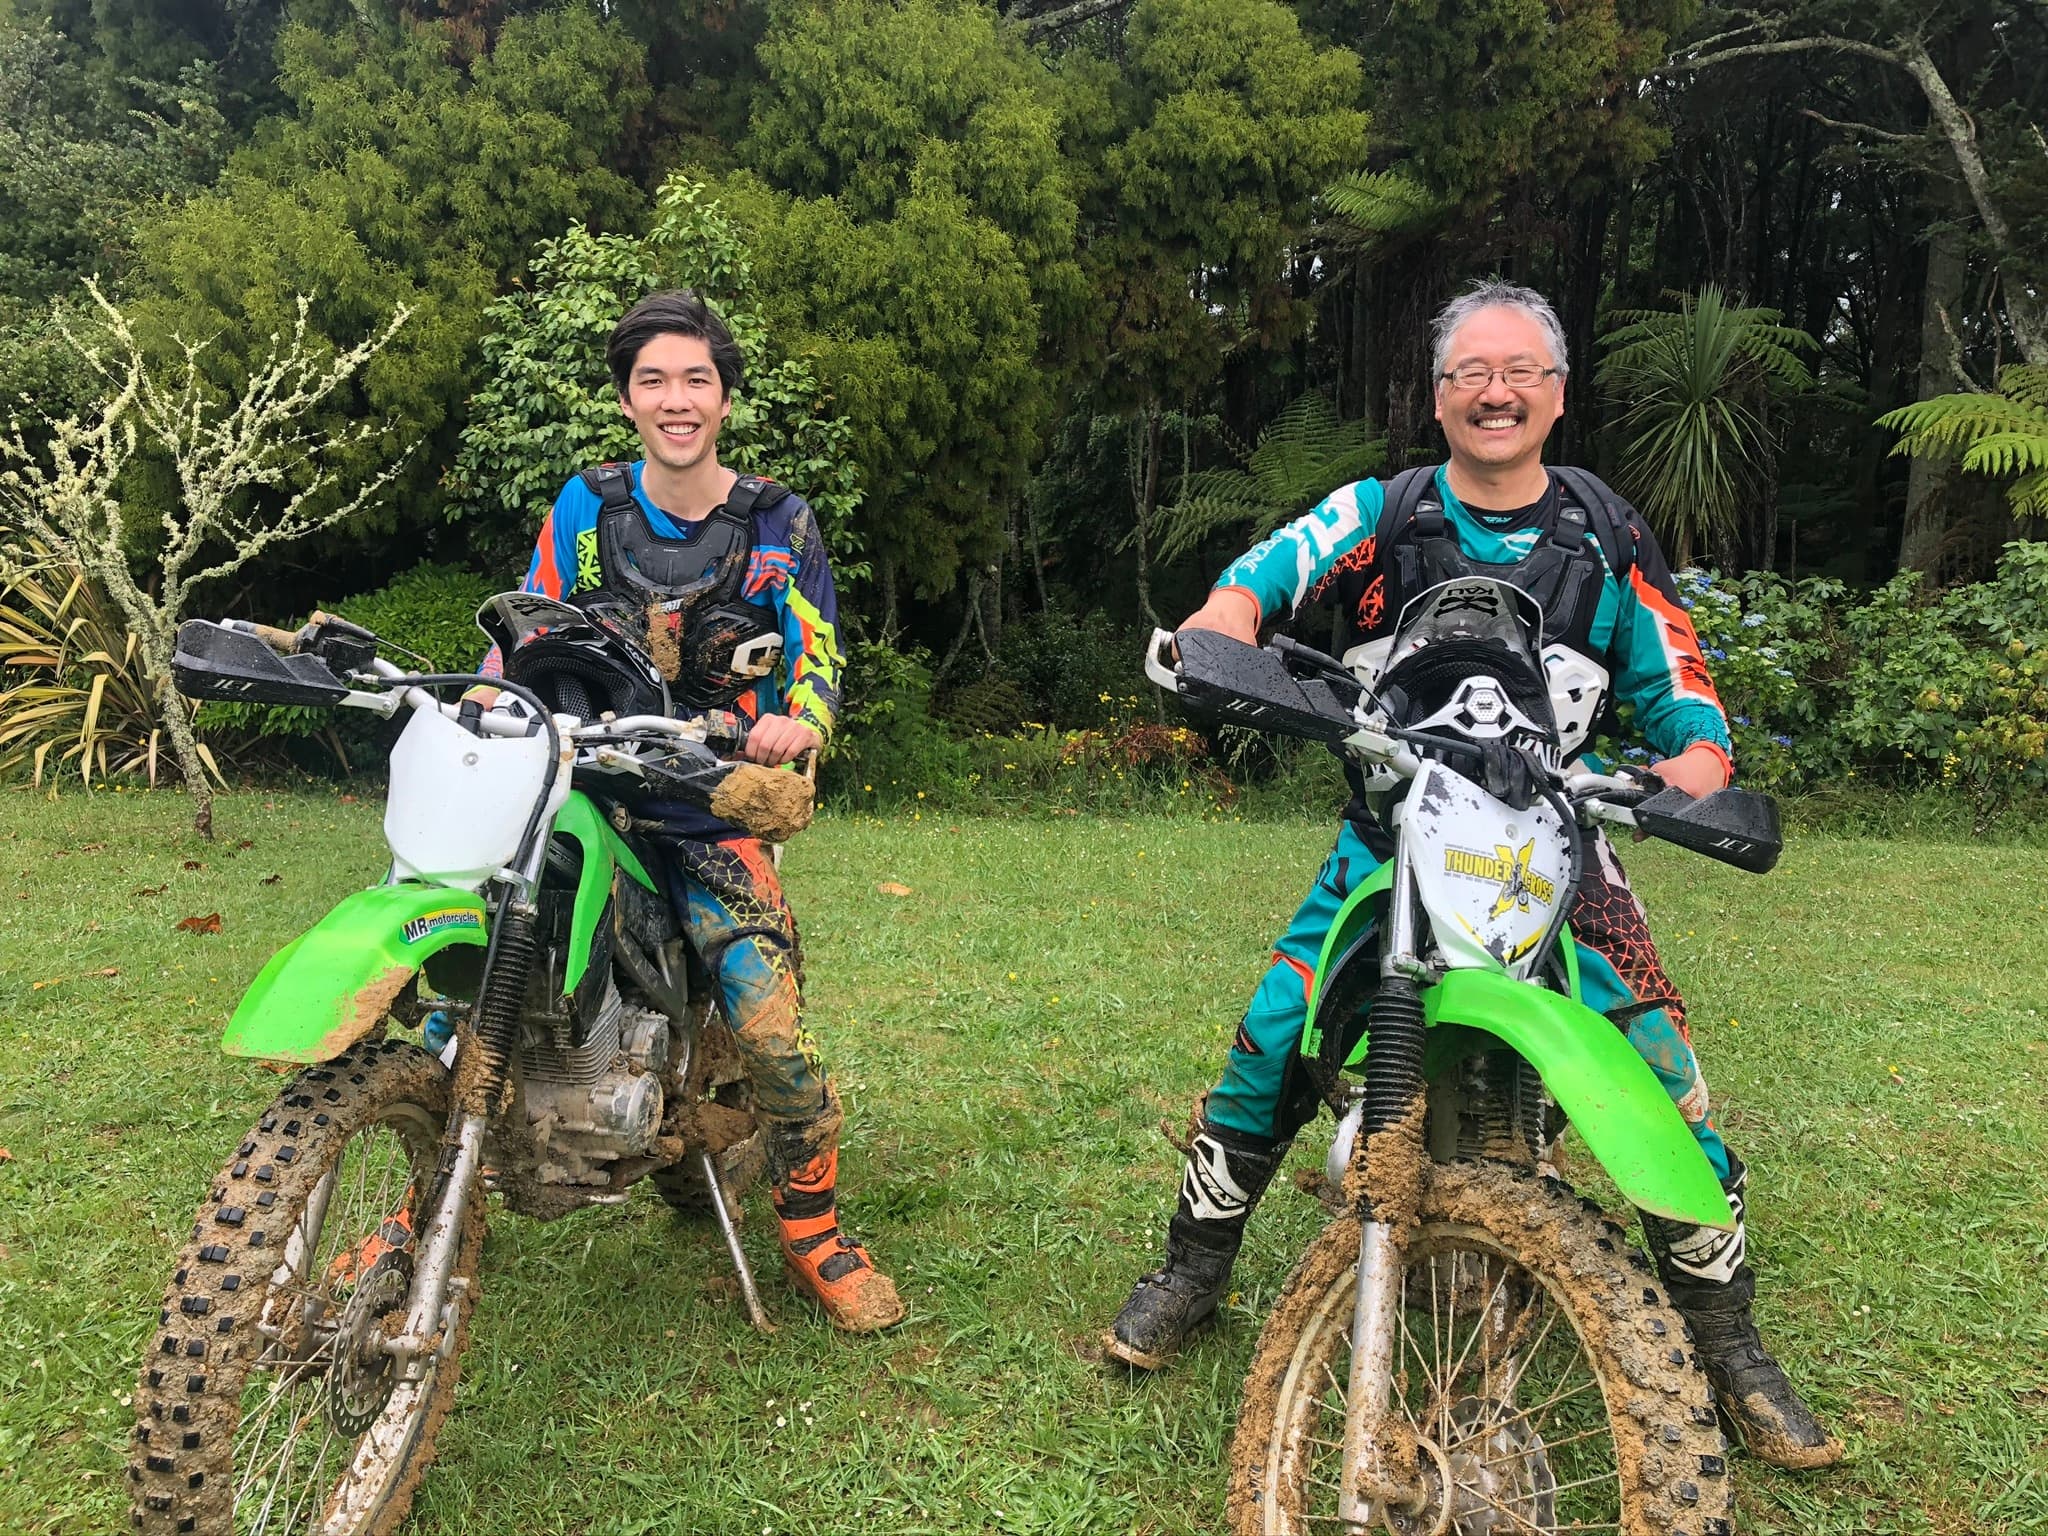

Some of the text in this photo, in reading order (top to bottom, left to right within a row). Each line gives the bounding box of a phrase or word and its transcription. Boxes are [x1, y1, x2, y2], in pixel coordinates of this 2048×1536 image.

[1444, 848, 1514, 882] THUNDER
[1521, 870, 1555, 906] CROSS
[404, 911, 478, 941] MR motorcycles
